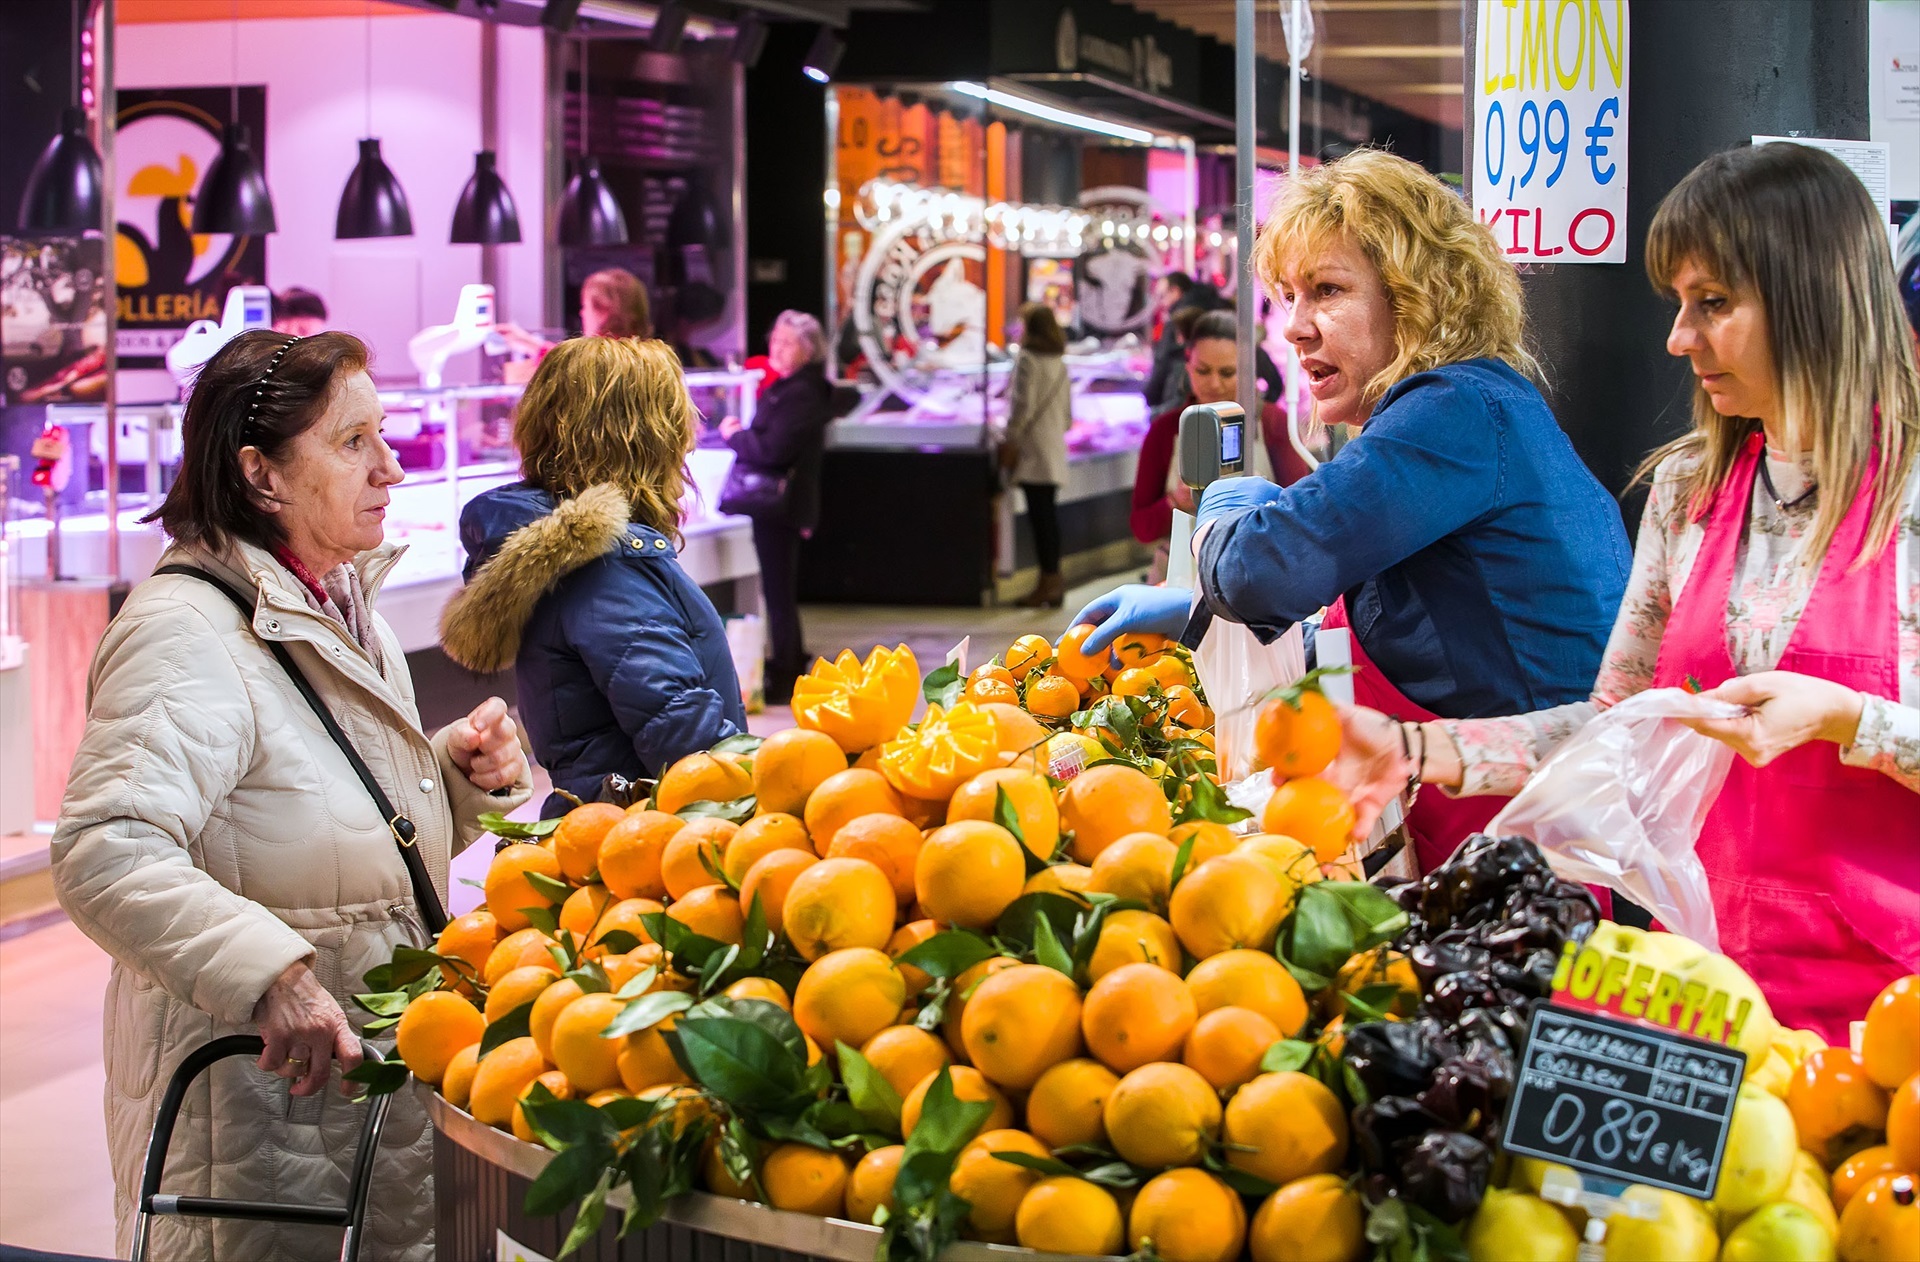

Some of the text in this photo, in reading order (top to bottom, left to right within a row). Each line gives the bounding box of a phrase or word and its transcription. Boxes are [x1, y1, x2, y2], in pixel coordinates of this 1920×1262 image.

[1485, 99, 1570, 201] 0,99
[1585, 96, 1620, 186] €
[1551, 940, 1752, 1046] ¡OFERTA!
[1535, 1051, 1628, 1089] GOLDEN
